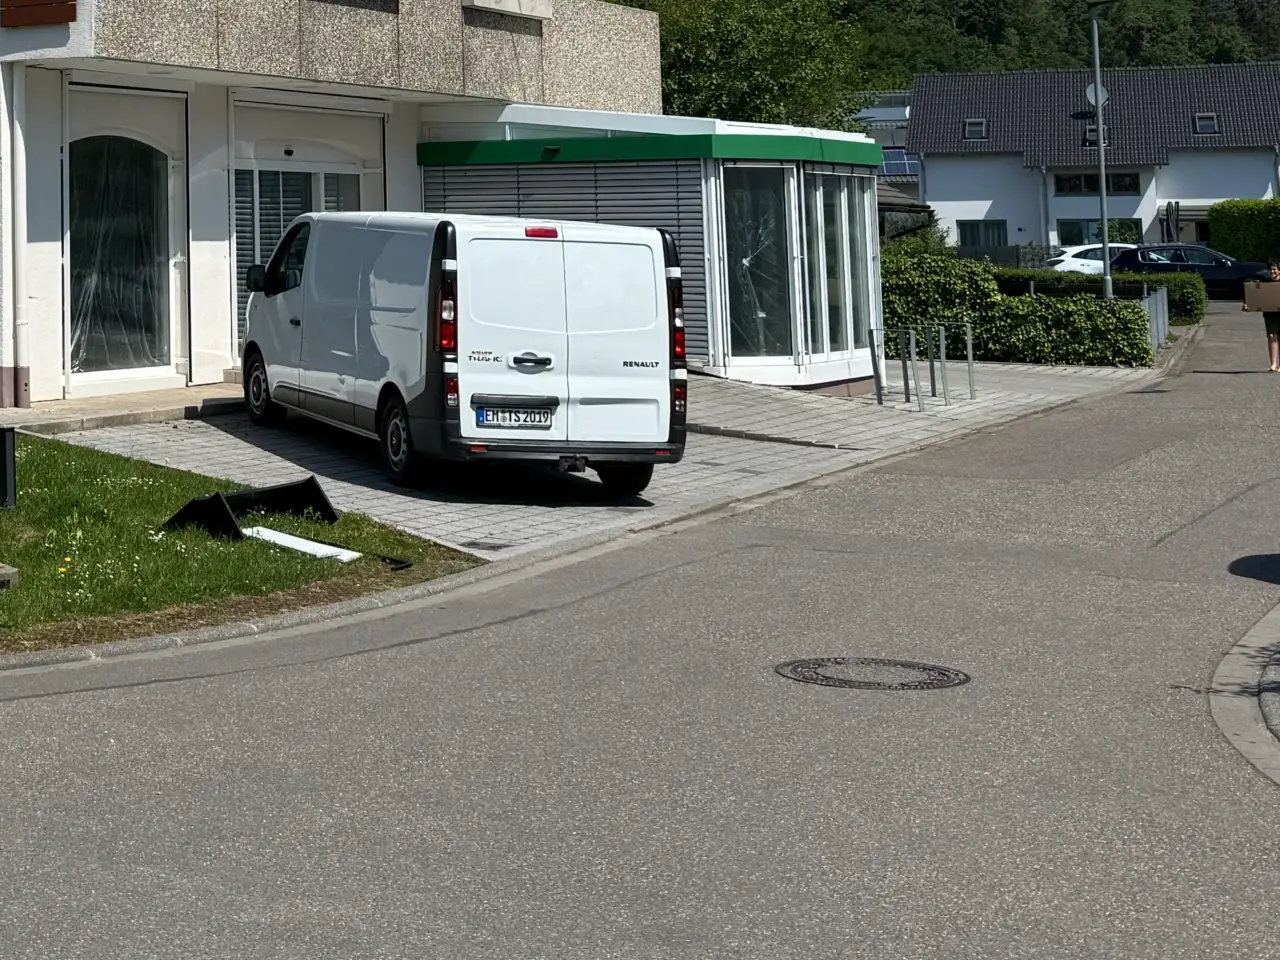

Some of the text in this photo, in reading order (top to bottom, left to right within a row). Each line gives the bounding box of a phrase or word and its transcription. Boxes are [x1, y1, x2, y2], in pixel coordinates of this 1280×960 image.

[622, 360, 660, 368] RENAULT
[507, 409, 521, 423] TS
[523, 410, 549, 424] 2019
